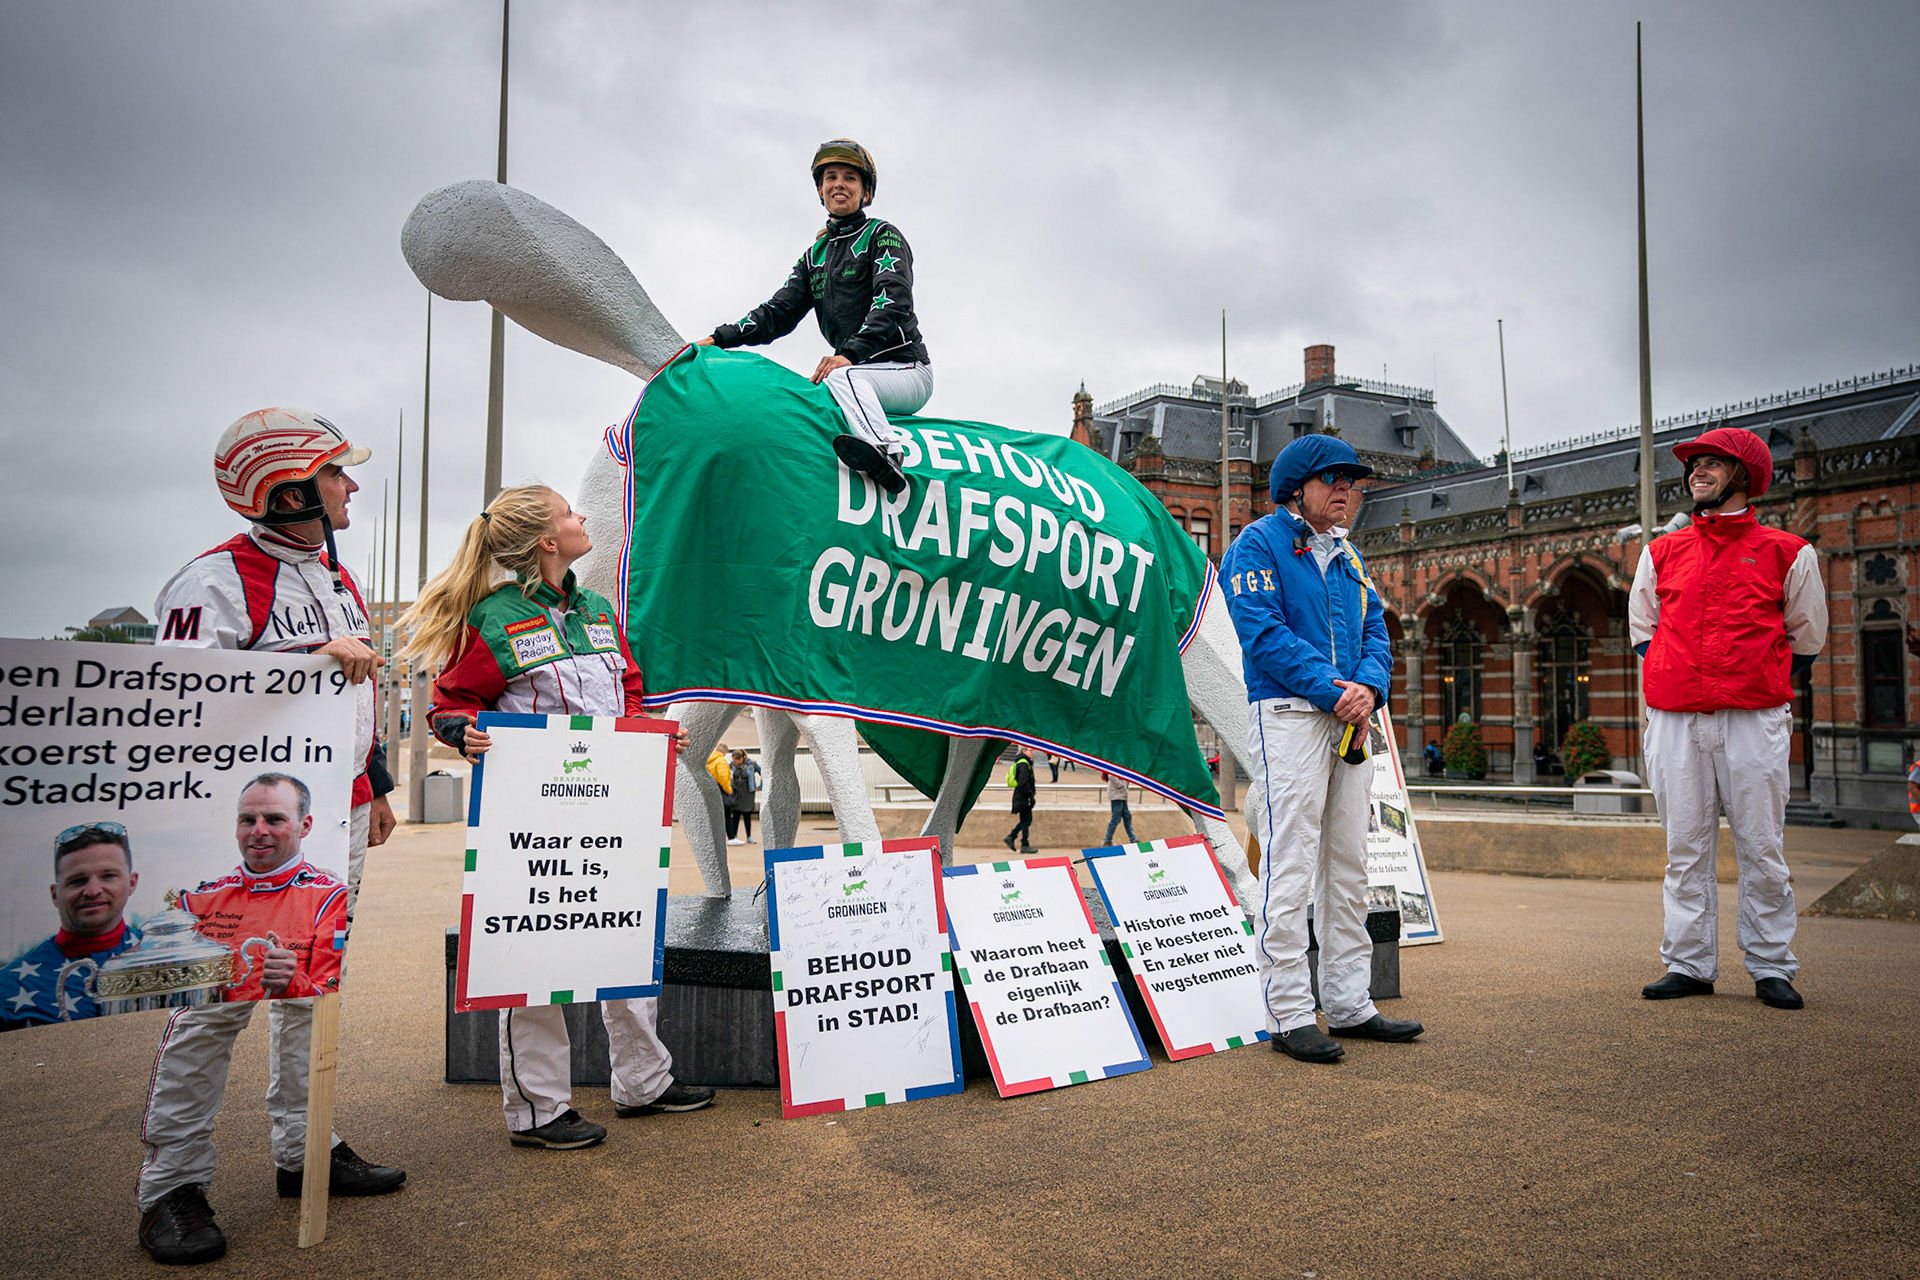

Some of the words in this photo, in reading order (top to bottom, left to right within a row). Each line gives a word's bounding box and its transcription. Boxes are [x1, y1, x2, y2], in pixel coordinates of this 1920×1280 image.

[890, 426, 1105, 523] BEHOUD
[837, 458, 1155, 613] DRAFSPORT
[162, 606, 203, 641] M
[808, 546, 1136, 698] GRONINGEN
[516, 632, 553, 649] Payday
[521, 643, 556, 660] Racing
[75, 659, 255, 700] Drafsport
[265, 668, 348, 695] 2019
[0, 695, 203, 728] derlander!
[127, 735, 292, 773] geregeld
[304, 737, 333, 763] in
[3, 771, 212, 810] Stadspark.
[541, 783, 610, 798] GRONINGEN
[1370, 791, 1401, 802] Stadspark?
[509, 832, 573, 850] Waar
[580, 835, 623, 849] een
[528, 859, 573, 877] WIL
[582, 858, 609, 879] is,
[529, 887, 550, 904] Is
[559, 886, 598, 903] het
[837, 896, 876, 904] DRAFBAAN
[1143, 885, 1188, 901] GRONINGEN
[484, 910, 642, 934] STADSPARK!
[828, 901, 887, 918] GRONINGEN
[993, 907, 1044, 923] GRONINGEN
[1123, 913, 1186, 934] Historie
[1189, 904, 1229, 923] moet
[970, 944, 1044, 963] Waarom
[1047, 937, 1086, 953] heet
[1136, 939, 1153, 956] je
[1155, 925, 1238, 950] koesteren.
[807, 948, 912, 976] BEHOUD
[983, 969, 1006, 983] de
[1010, 959, 1090, 979] Drafbaan
[1143, 957, 1165, 973] En
[1167, 951, 1210, 969] zeker
[1214, 942, 1245, 959] niet
[787, 973, 935, 1007] DRAFSPORT
[1007, 978, 1083, 1002] eigenlijk
[1151, 963, 1260, 993] wegstemmen.
[817, 1015, 840, 1032] in
[847, 1003, 919, 1028] STAD!
[995, 1011, 1018, 1026] de
[1022, 995, 1111, 1021] Drafbaan?
